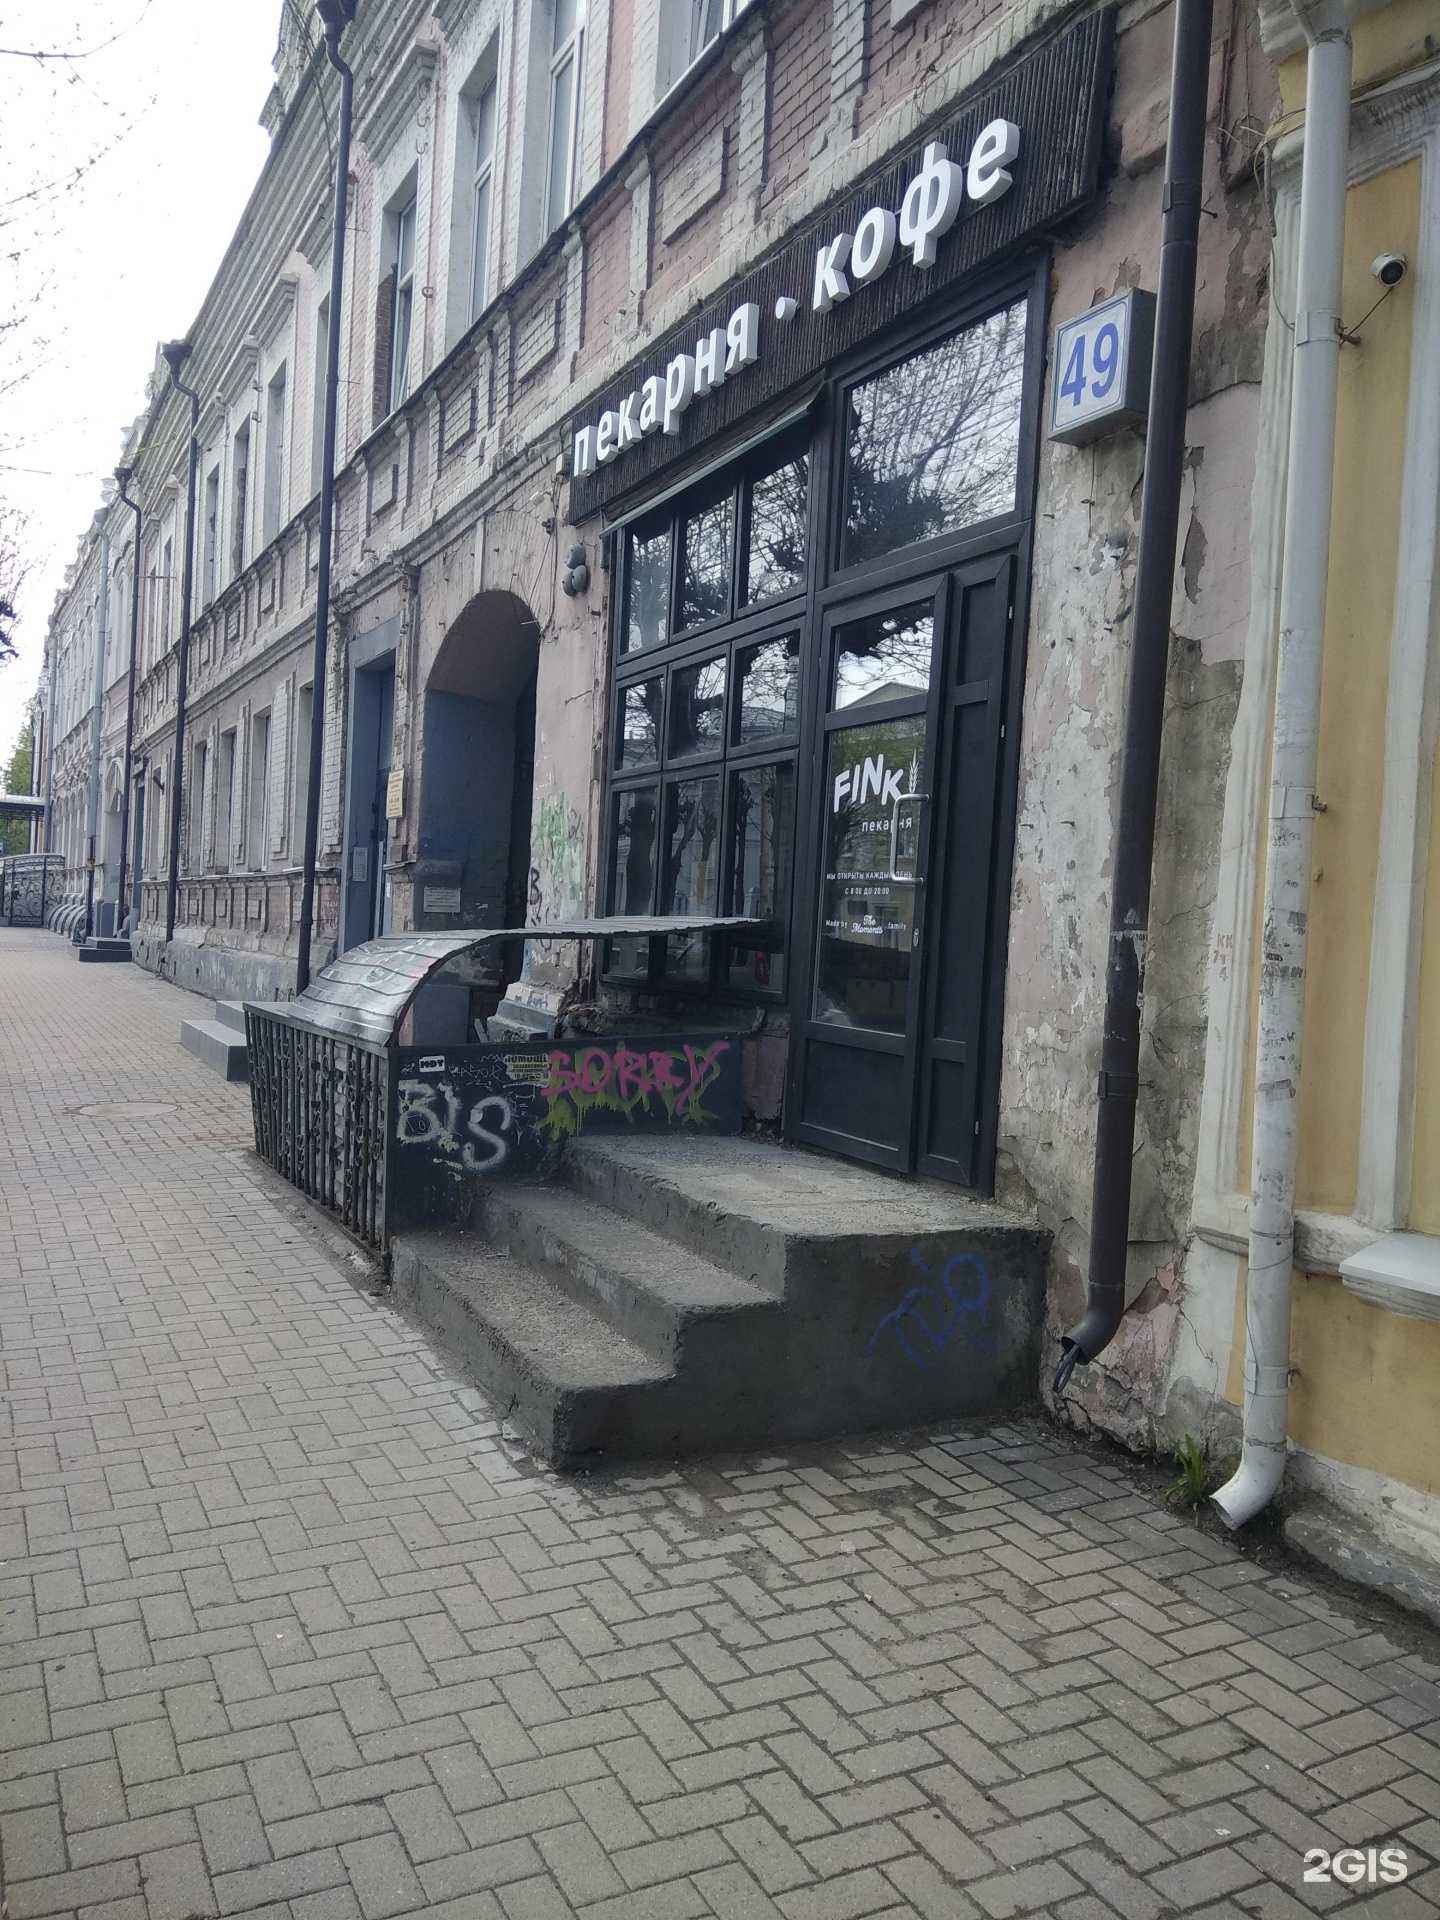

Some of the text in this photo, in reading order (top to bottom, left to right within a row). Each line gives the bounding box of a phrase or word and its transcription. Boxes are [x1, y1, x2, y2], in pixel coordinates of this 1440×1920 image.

[574, 118, 1020, 477] пекарня кофе
[1060, 323, 1119, 407] 49
[833, 753, 904, 813] FINK
[861, 817, 912, 833] пеканя
